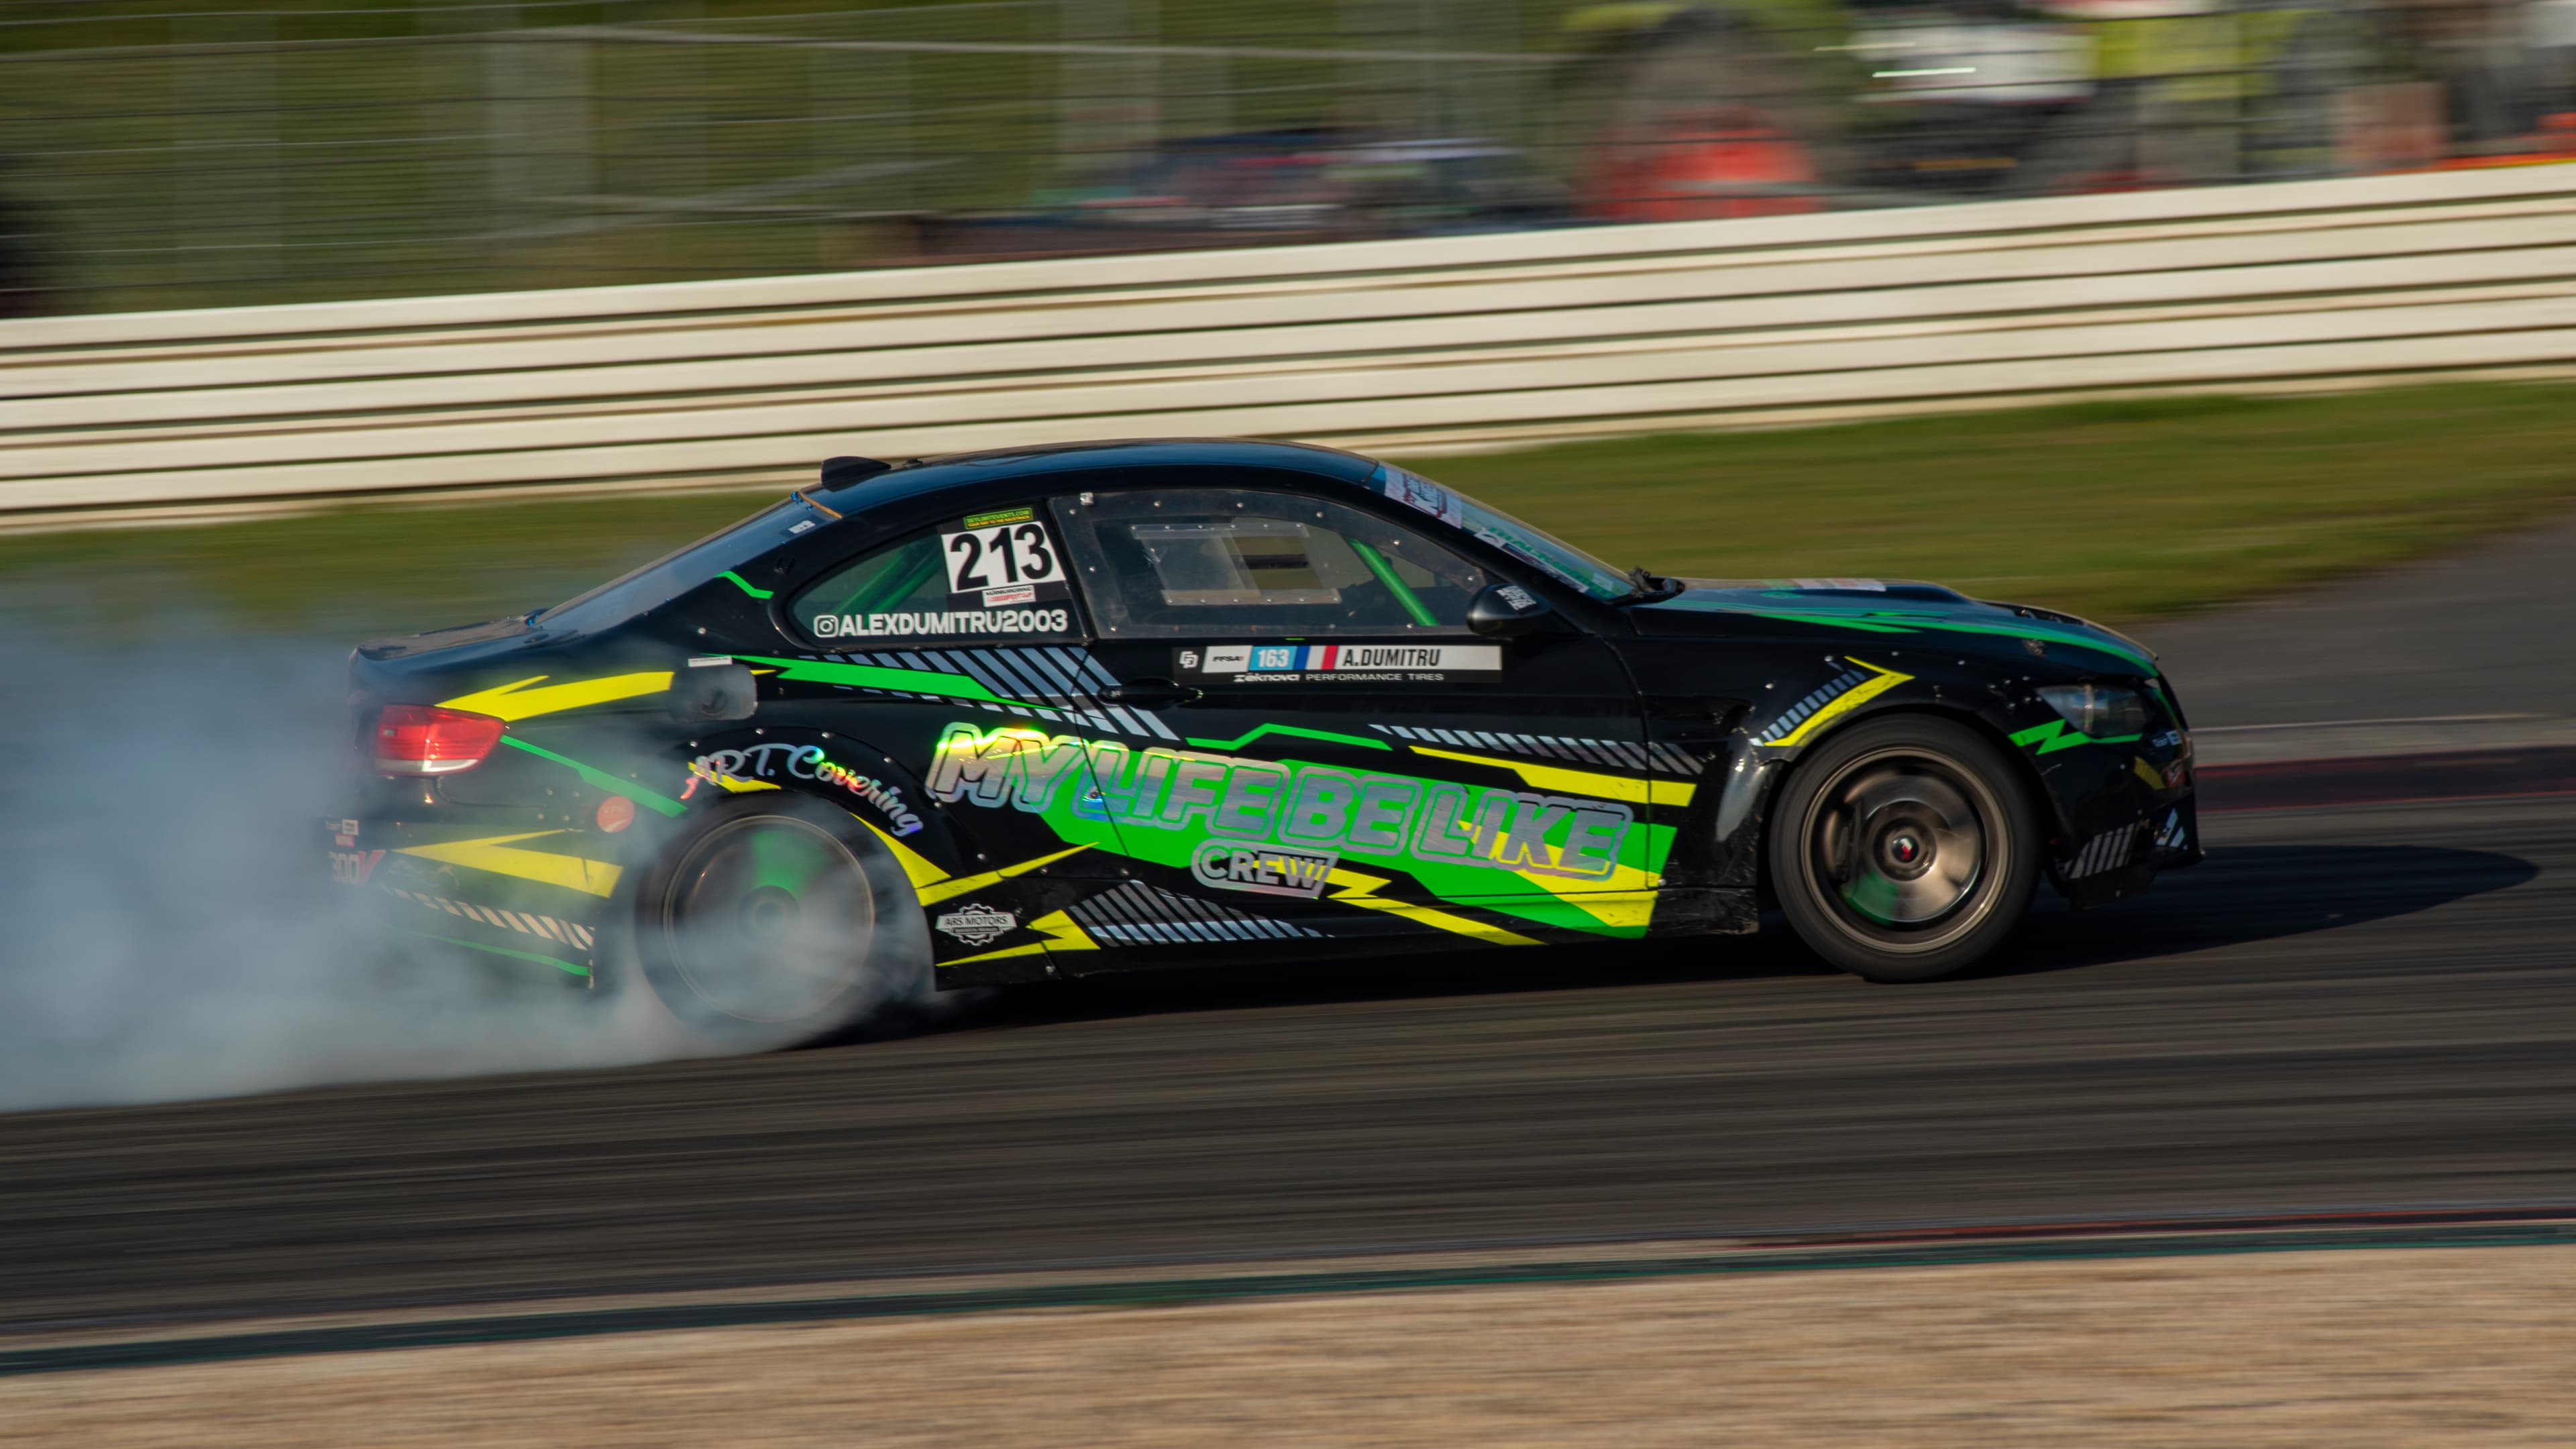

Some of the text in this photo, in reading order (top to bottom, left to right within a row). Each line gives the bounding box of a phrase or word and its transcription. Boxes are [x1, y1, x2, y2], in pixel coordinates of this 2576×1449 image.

[950, 523, 1052, 591] 213
[1258, 649, 1289, 667] 163
[1343, 648, 1441, 666] A.DUMITRU
[1305, 673, 1402, 682] PERFORMANCE
[1407, 673, 1444, 682] TIRES
[787, 745, 924, 838] Covering
[925, 722, 1635, 882] MY LIFE BE LIKE
[1199, 843, 1326, 890] CREW
[966, 916, 1008, 926] MOTORS
